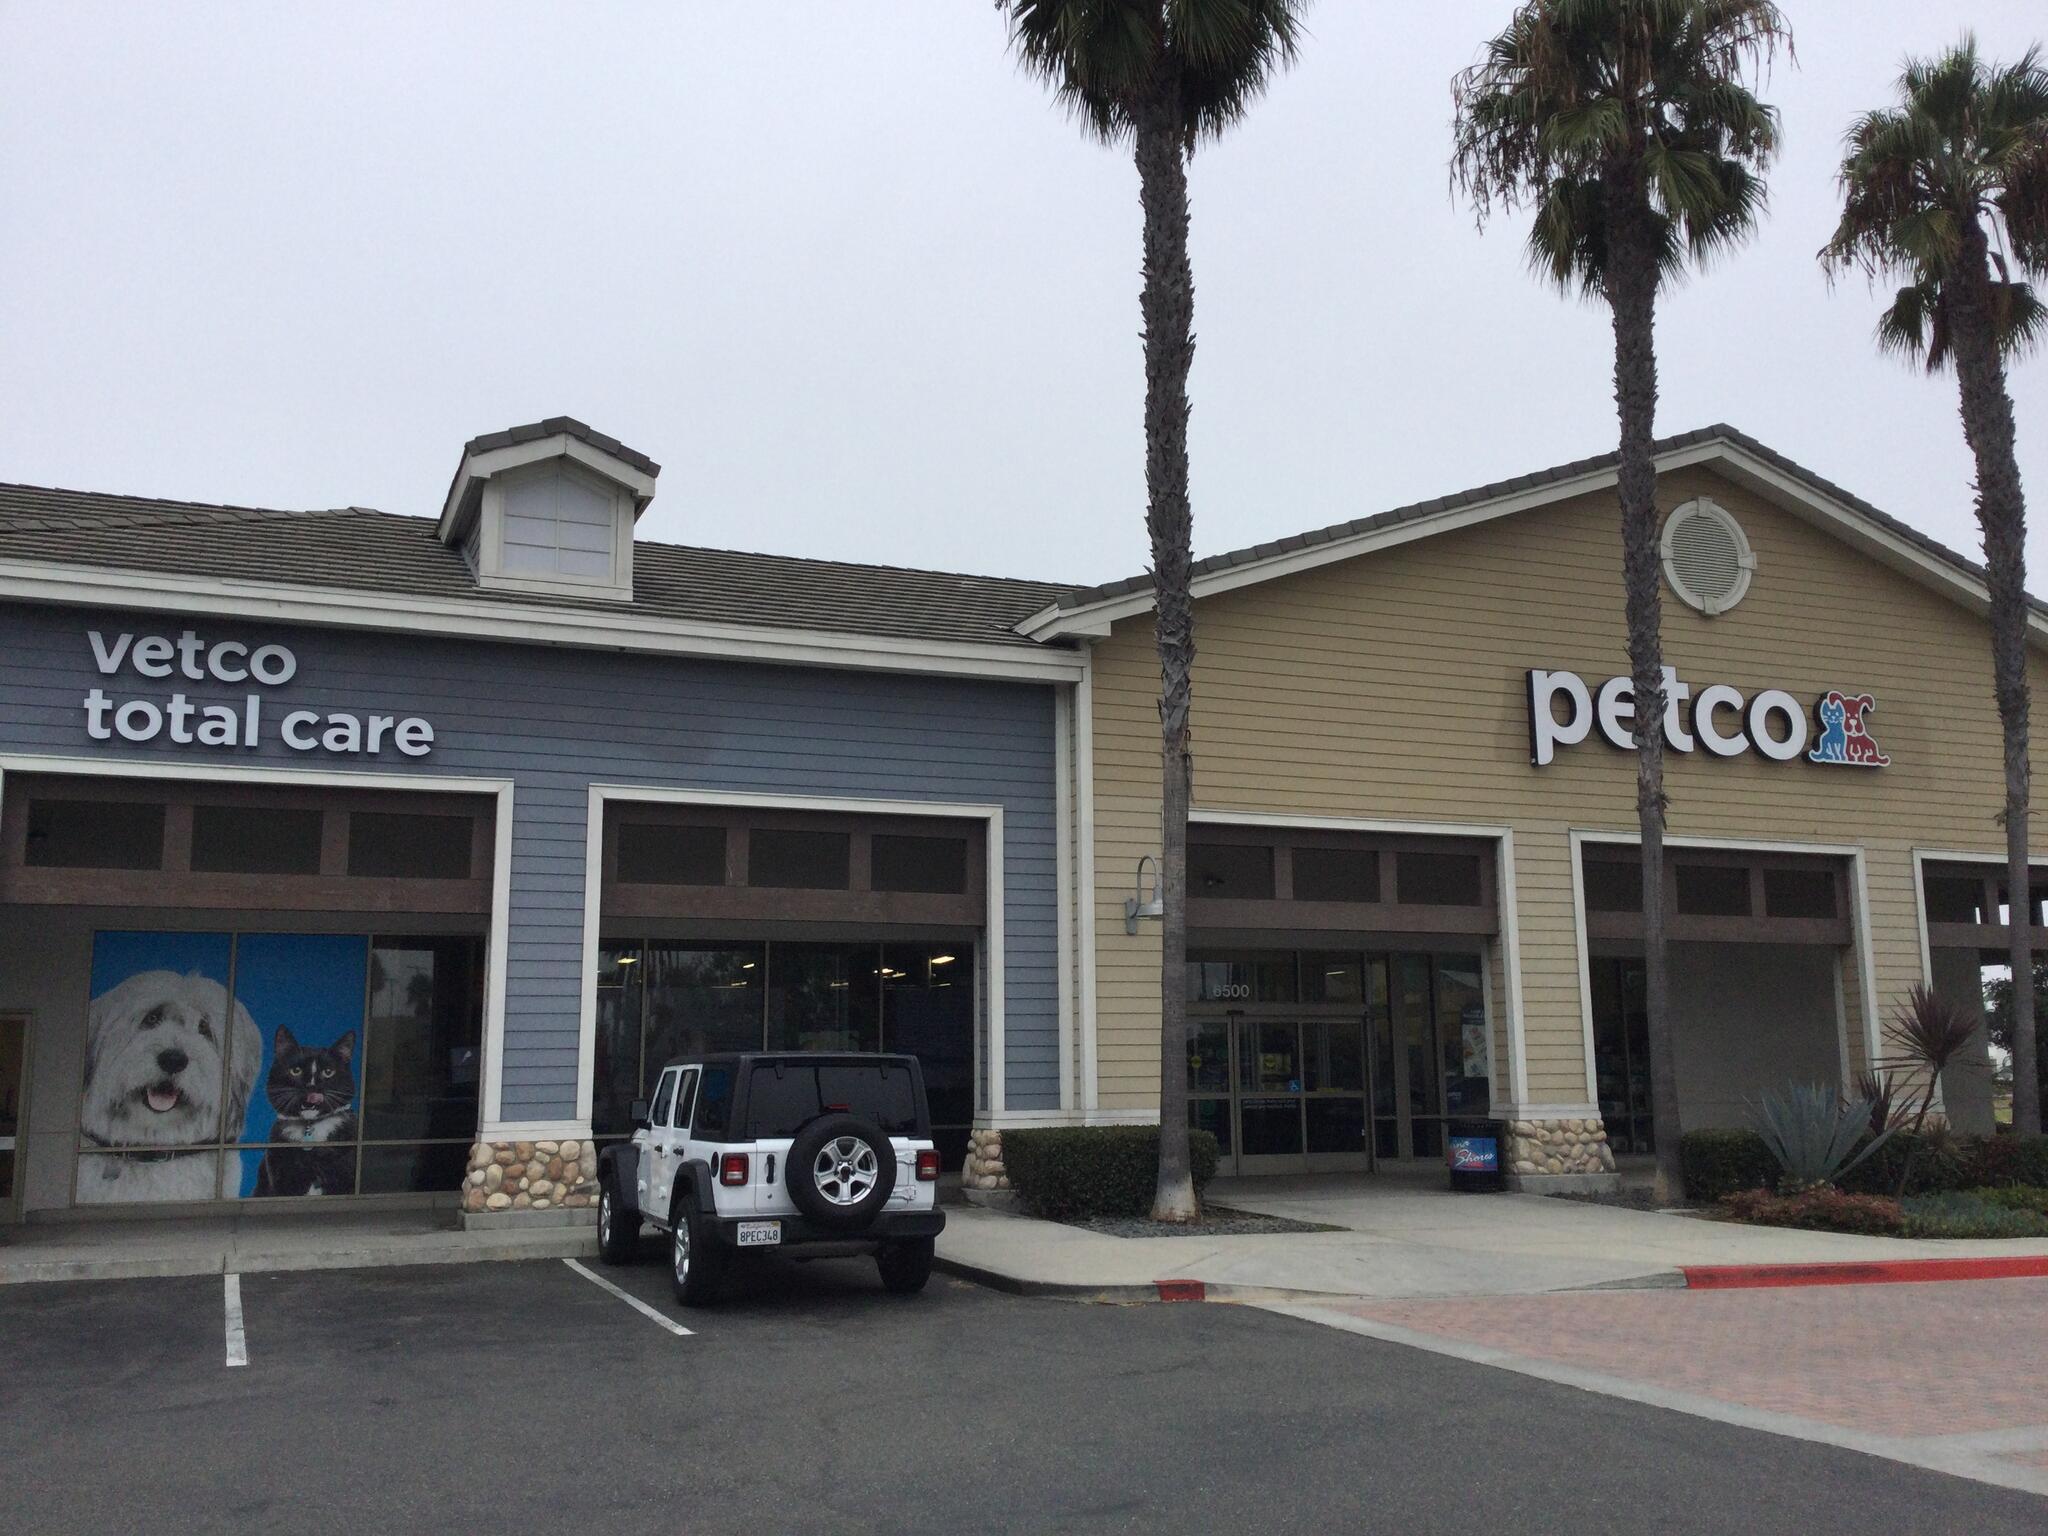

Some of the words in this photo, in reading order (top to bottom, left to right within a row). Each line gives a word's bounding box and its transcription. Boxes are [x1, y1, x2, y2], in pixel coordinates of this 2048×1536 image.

[87, 630, 297, 686] vetco
[84, 688, 260, 747] total
[281, 710, 435, 757] care
[1527, 665, 1808, 766] petco
[1213, 983, 1250, 998] 6500
[740, 1230, 778, 1243] 8PEC348
